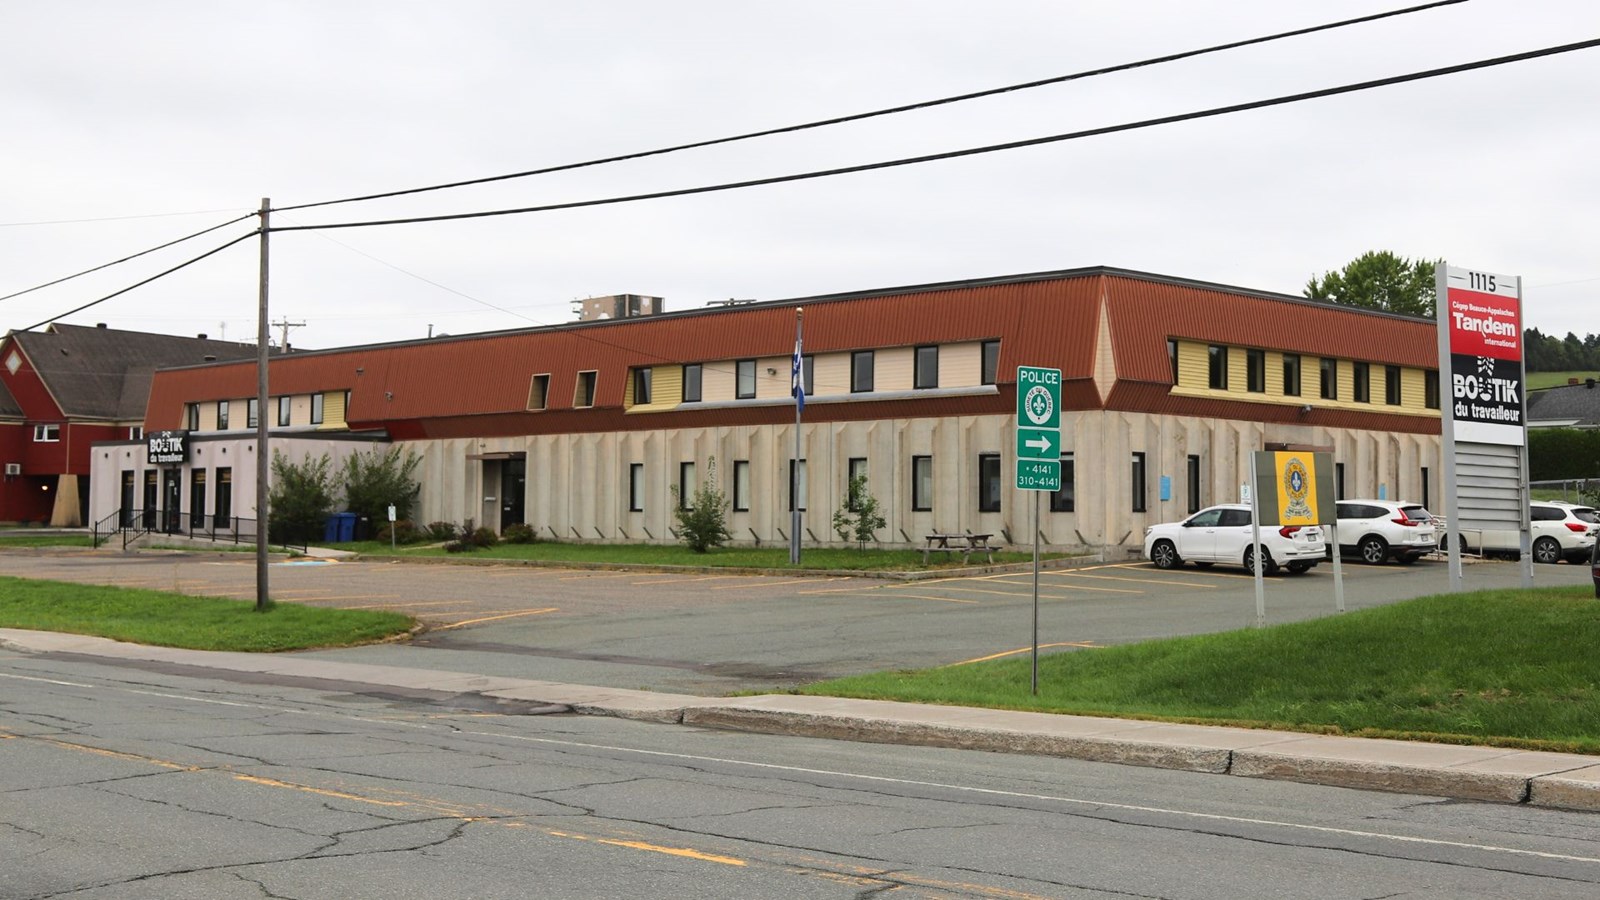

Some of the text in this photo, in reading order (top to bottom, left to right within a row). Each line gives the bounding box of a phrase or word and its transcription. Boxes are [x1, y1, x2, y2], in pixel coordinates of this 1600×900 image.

[1469, 271, 1496, 292] 1115
[1452, 311, 1516, 337] Tandem
[1020, 370, 1058, 384] POLICE
[1455, 401, 1520, 422] du travailleur
[1032, 464, 1052, 474] 4141
[1018, 475, 1058, 486] 310-4141
